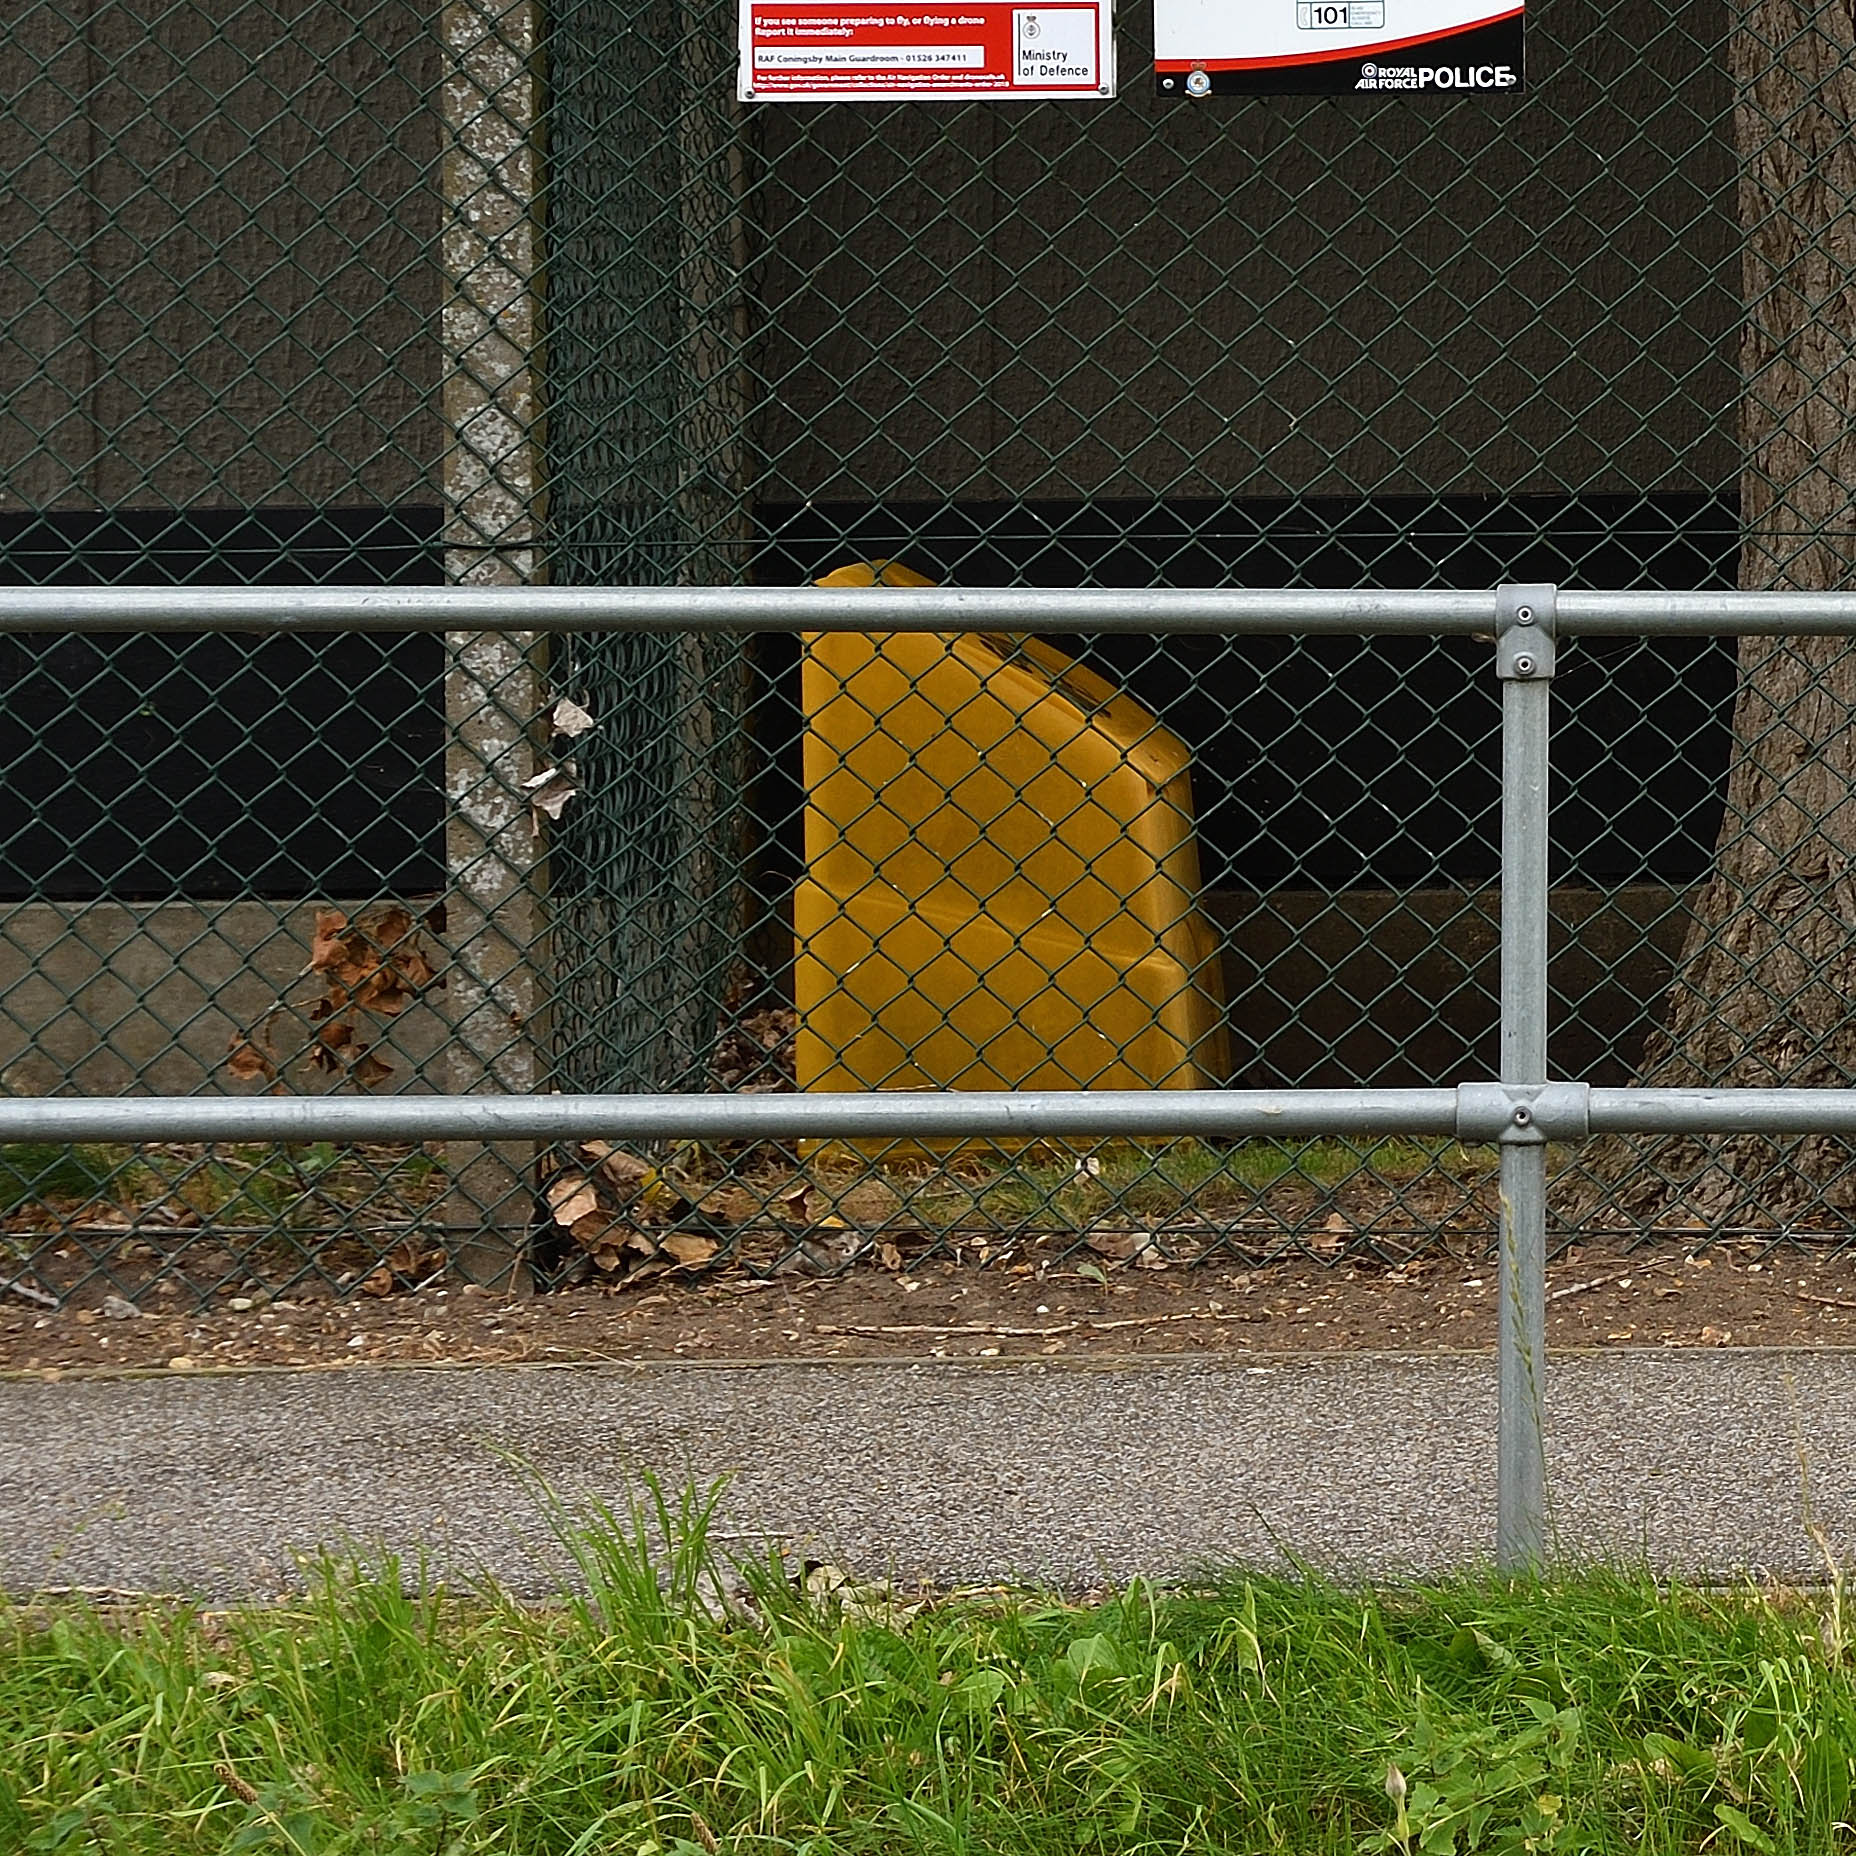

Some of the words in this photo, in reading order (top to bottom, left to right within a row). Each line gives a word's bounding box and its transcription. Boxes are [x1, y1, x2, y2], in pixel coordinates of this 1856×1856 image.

[1313, 6, 1347, 25] 101
[757, 55, 775, 63] RAF
[776, 54, 823, 64] Coningsby
[825, 55, 847, 63] Main
[848, 54, 899, 63] Guardroom
[905, 54, 933, 62] 01526
[935, 54, 967, 62] 347411
[1022, 49, 1068, 63] Ministry
[1022, 65, 1034, 77] of
[1039, 64, 1089, 77] Defence
[1378, 67, 1418, 80] ROYAL
[1418, 63, 1517, 89] POLICE
[1354, 78, 1378, 90] AIR
[1378, 77, 1418, 90] FORCE
